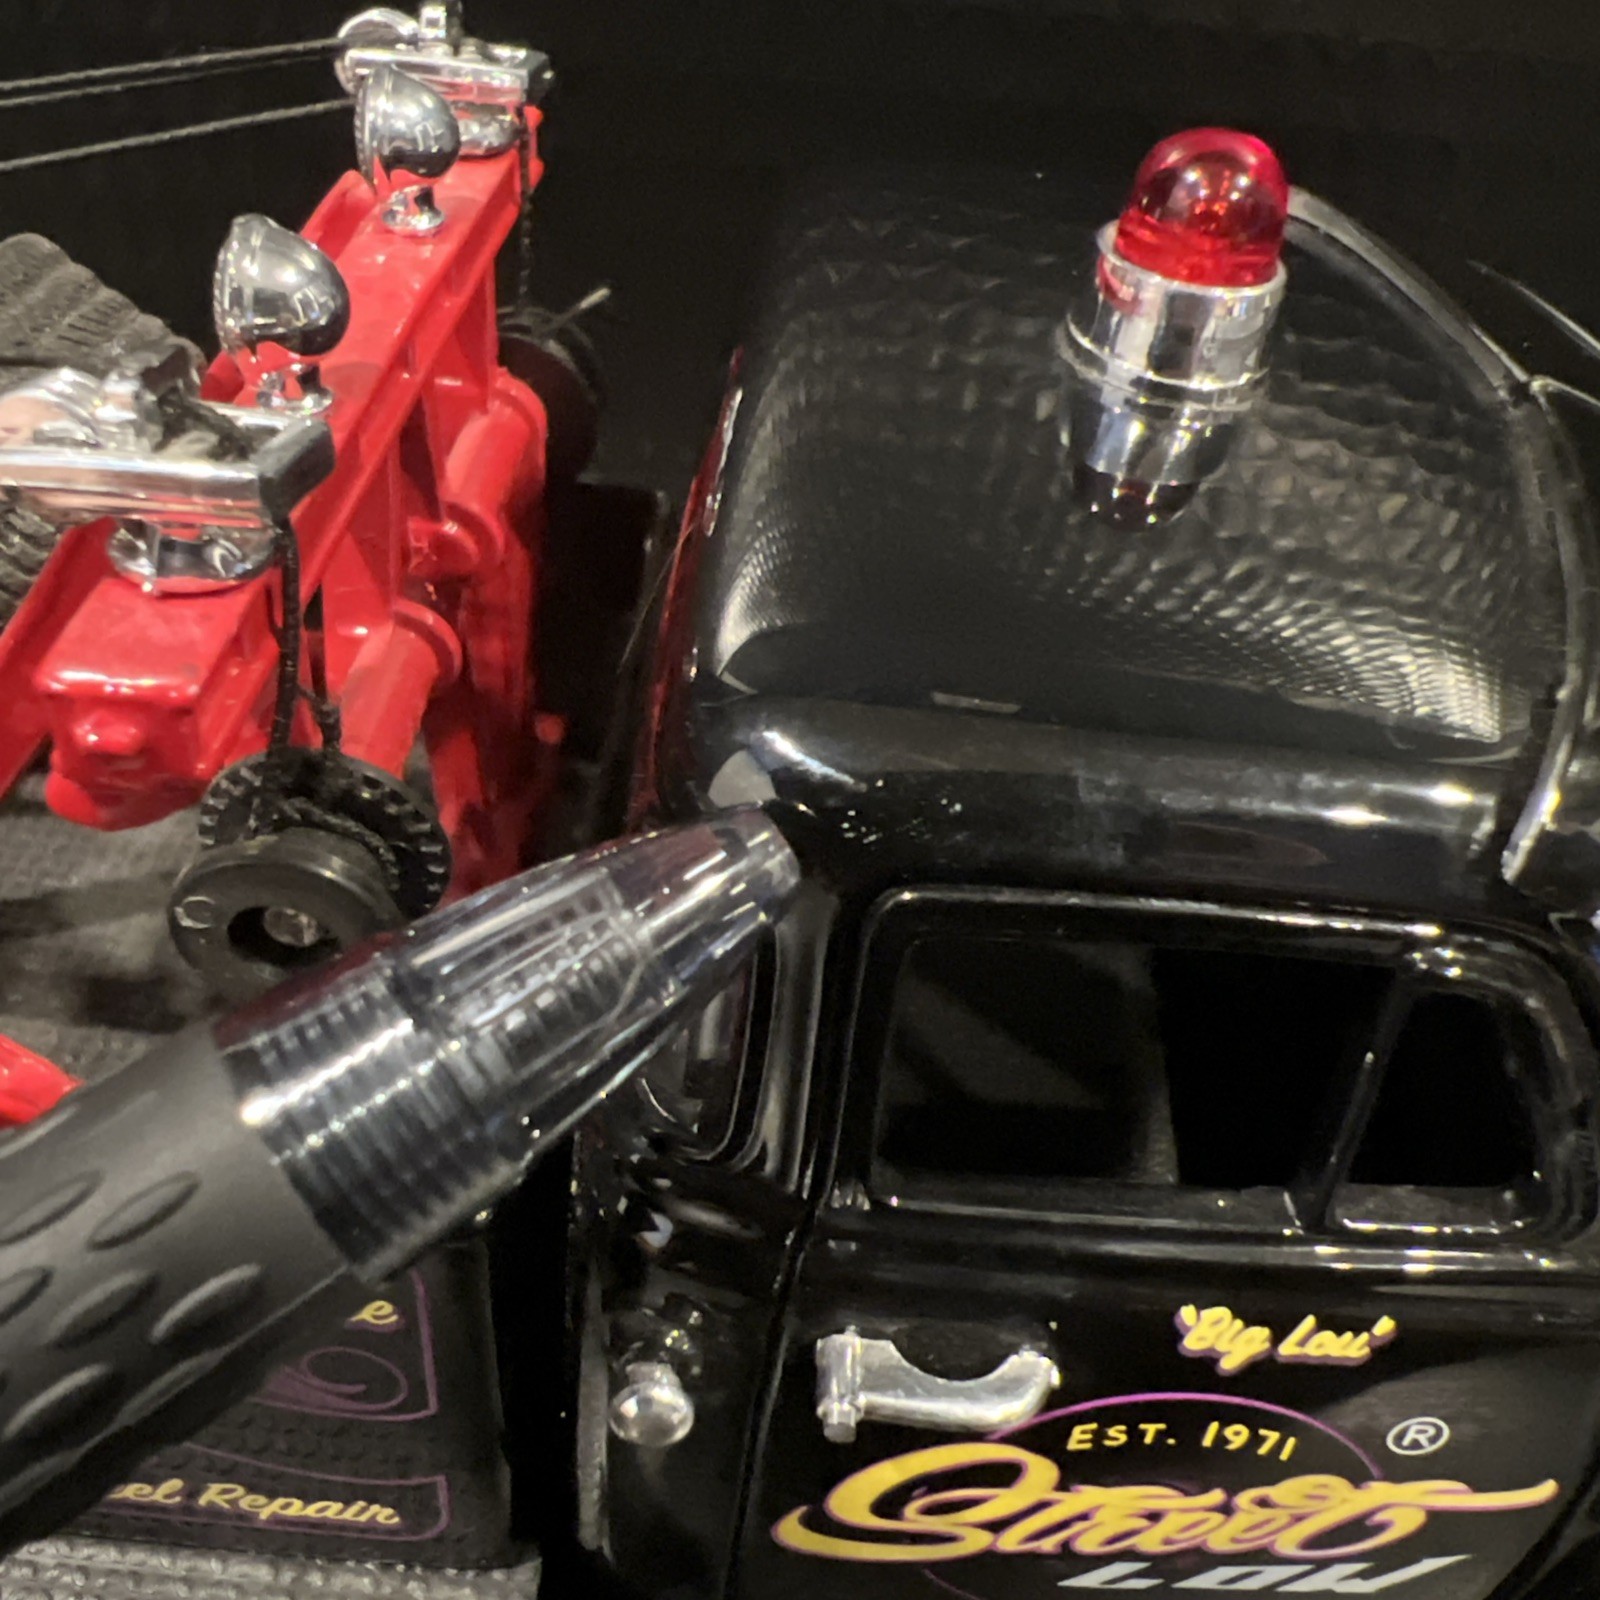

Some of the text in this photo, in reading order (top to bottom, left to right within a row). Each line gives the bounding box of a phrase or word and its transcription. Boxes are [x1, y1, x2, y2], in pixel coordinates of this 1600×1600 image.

[1066, 1420, 1297, 1462] EST. 1971
[106, 1478, 400, 1525] el Repair
[773, 1441, 1559, 1562] Street
[1057, 1554, 1472, 1594] LOW
